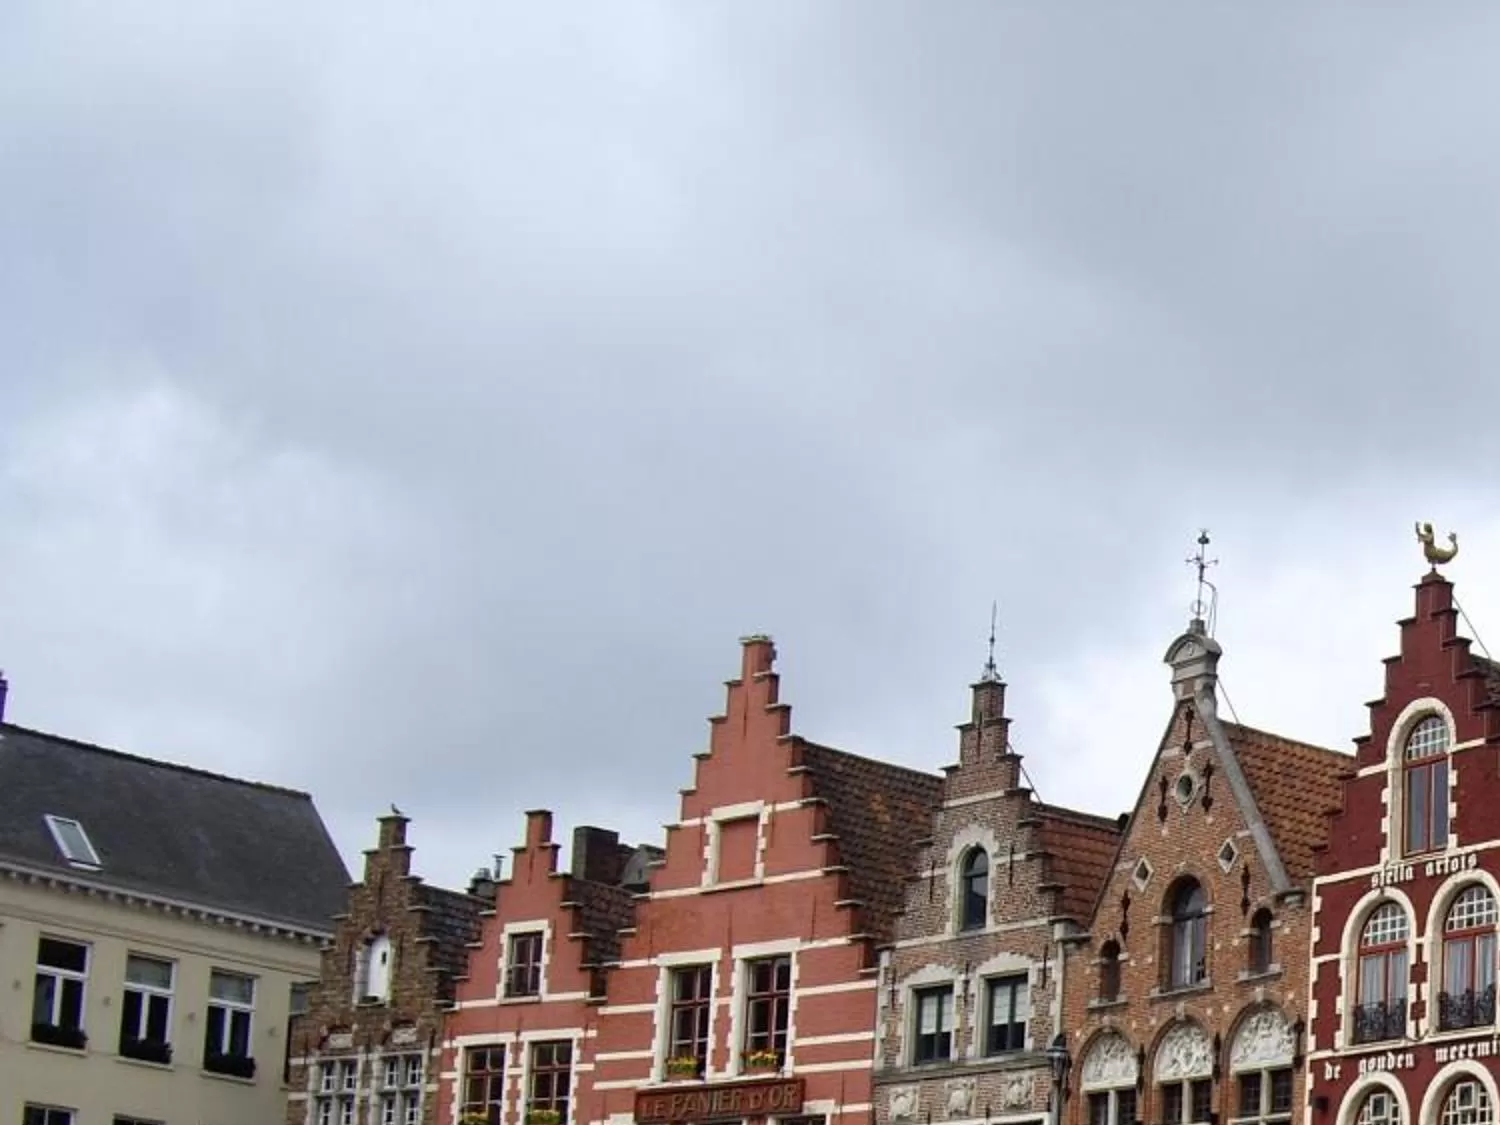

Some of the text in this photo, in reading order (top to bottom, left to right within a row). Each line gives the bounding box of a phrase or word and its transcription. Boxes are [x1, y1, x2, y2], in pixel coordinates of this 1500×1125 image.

[1324, 1061, 1341, 1081] de
[1358, 1051, 1415, 1076] gouden
[642, 1101, 666, 1117] LE
[671, 1087, 744, 1119] PANIER
